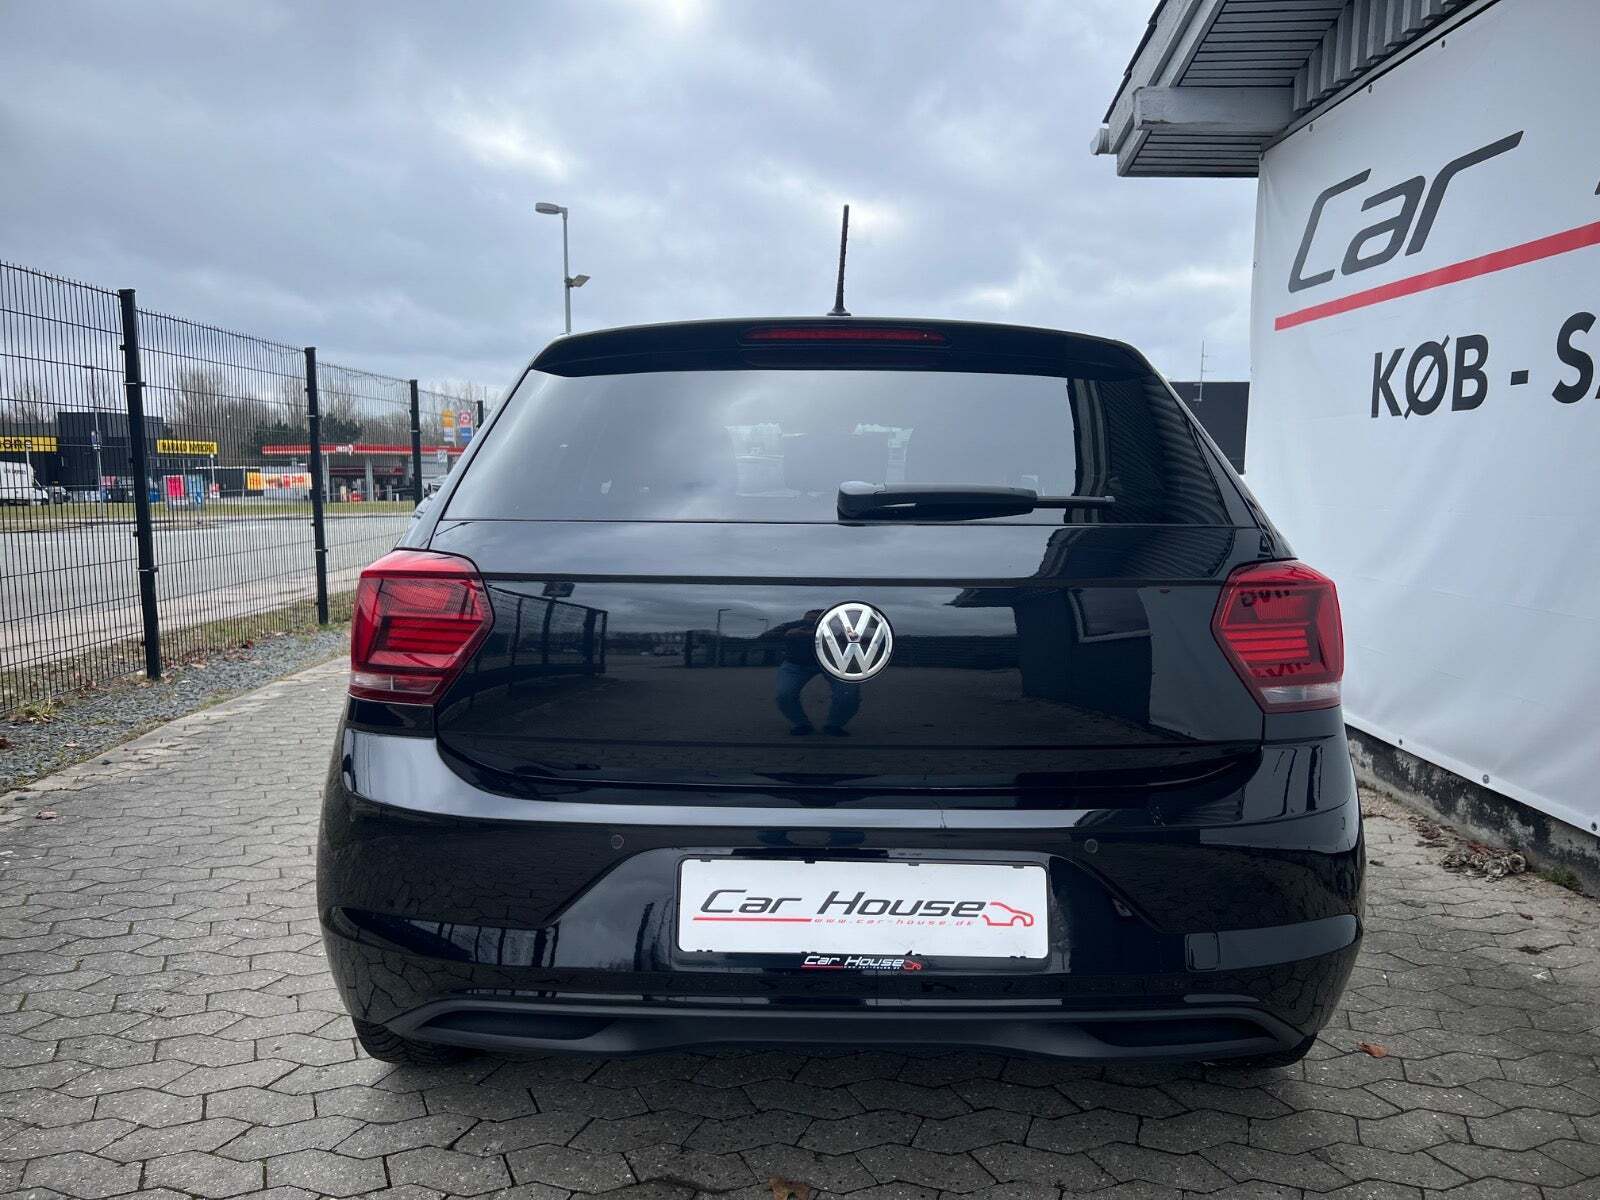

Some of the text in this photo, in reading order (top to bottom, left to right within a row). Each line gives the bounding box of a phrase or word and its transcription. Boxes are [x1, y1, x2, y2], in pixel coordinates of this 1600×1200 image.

[1288, 130, 1524, 293] Car
[1371, 334, 1489, 420] KØB
[1552, 311, 1600, 404] S
[815, 602, 893, 681] VW
[700, 889, 987, 918] Car House
[804, 955, 905, 967] Car House
